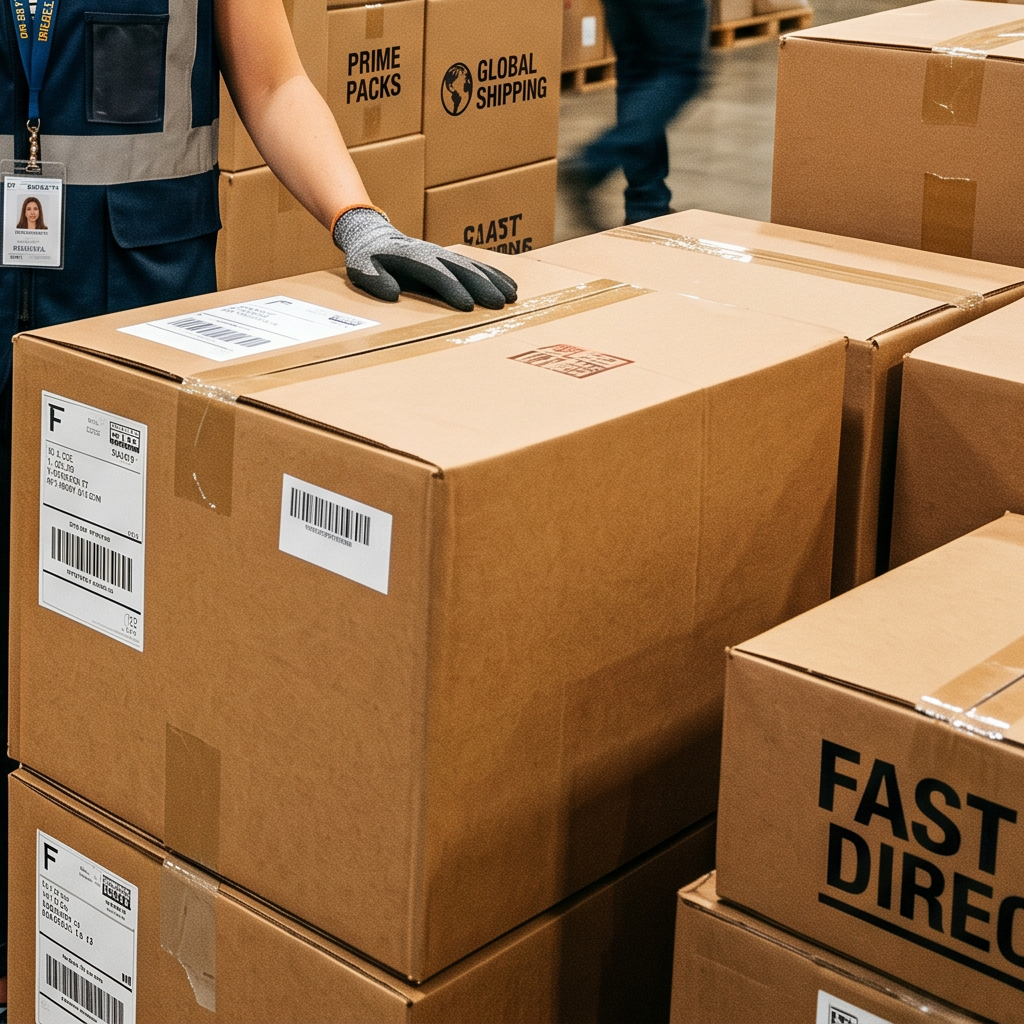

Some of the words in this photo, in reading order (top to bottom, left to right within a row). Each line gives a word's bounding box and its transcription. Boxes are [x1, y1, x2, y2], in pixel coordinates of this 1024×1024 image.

[347, 45, 401, 76] PRIME
[477, 52, 538, 83] GLOBAL
[346, 72, 402, 105] PACKS
[476, 76, 547, 110] SHIPPING
[47, 402, 65, 432] F
[817, 738, 1018, 876] FAST
[43, 841, 58, 871] F
